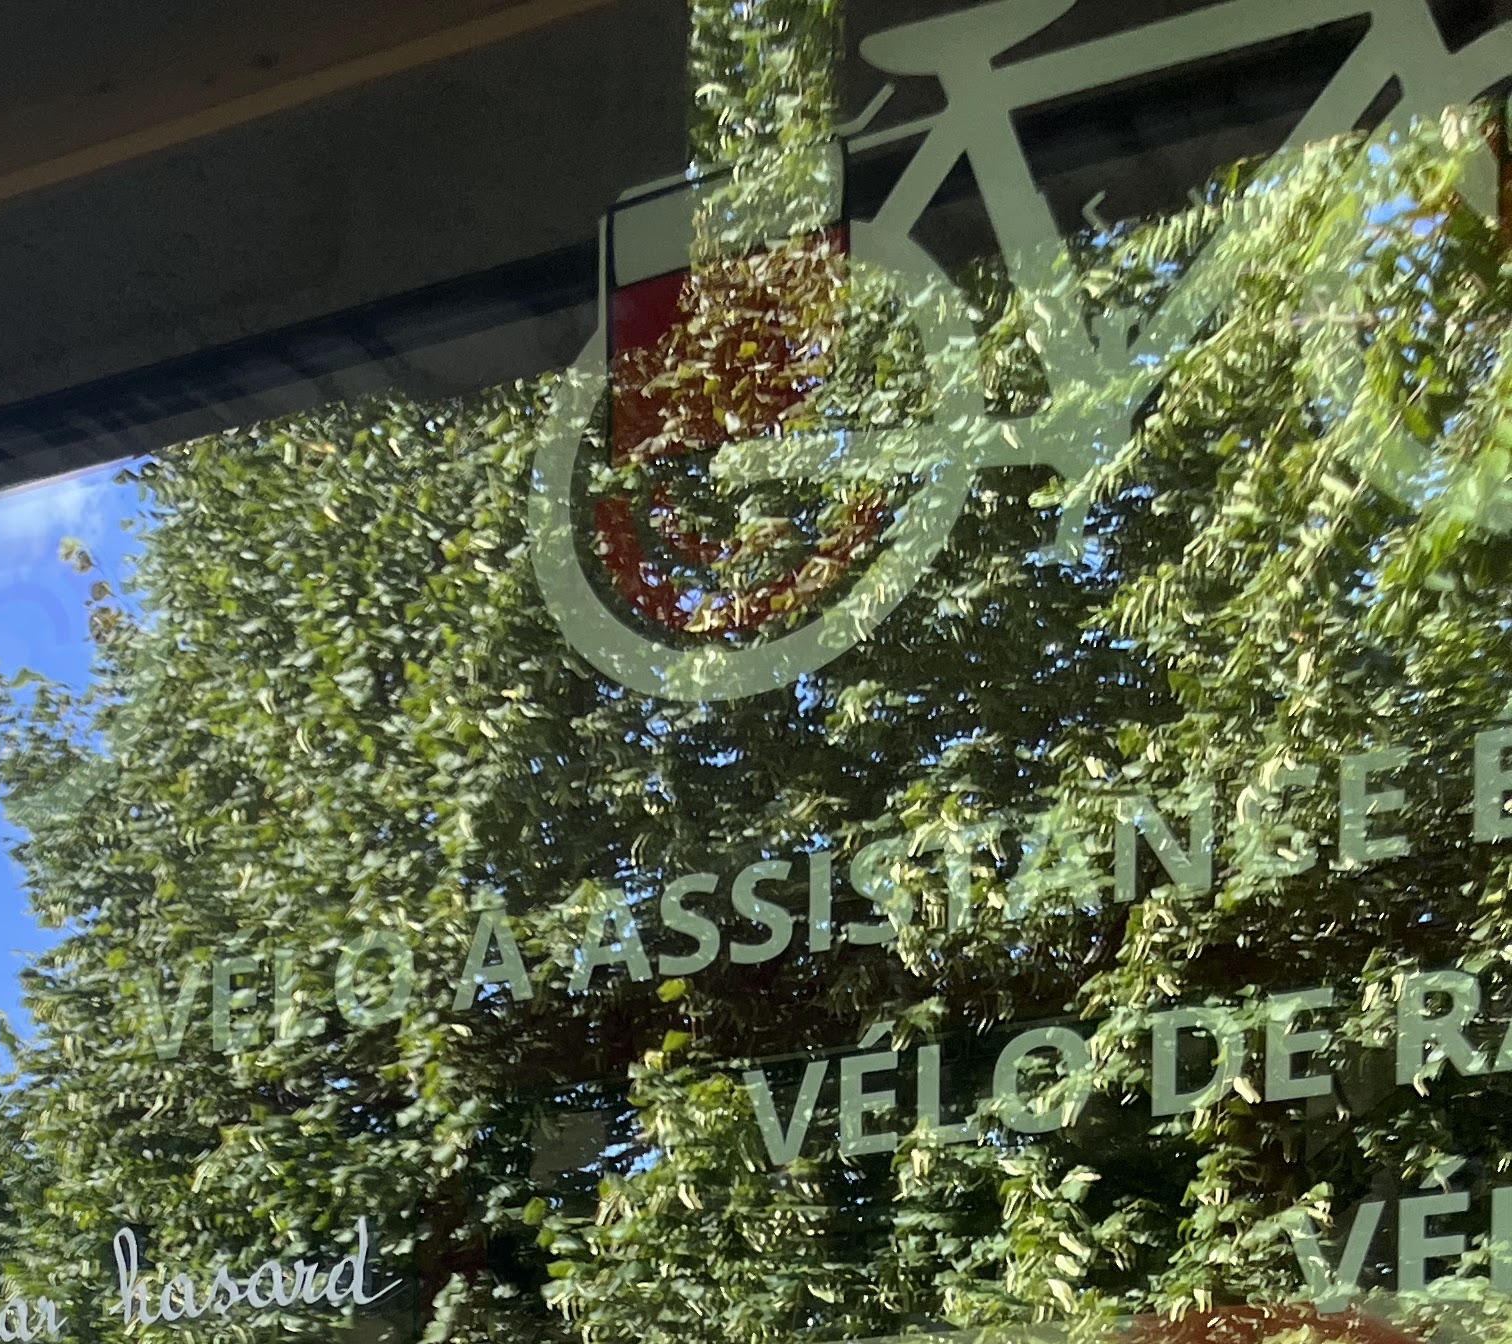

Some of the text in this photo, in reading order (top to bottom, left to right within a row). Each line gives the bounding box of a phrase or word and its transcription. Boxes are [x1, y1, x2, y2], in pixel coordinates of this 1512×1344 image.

[138, 928, 415, 1060] VÉLO
[567, 743, 1412, 992] ASSISTANCE
[744, 966, 1512, 1168] VÉLO DE R
[110, 1215, 402, 1326] hasard
